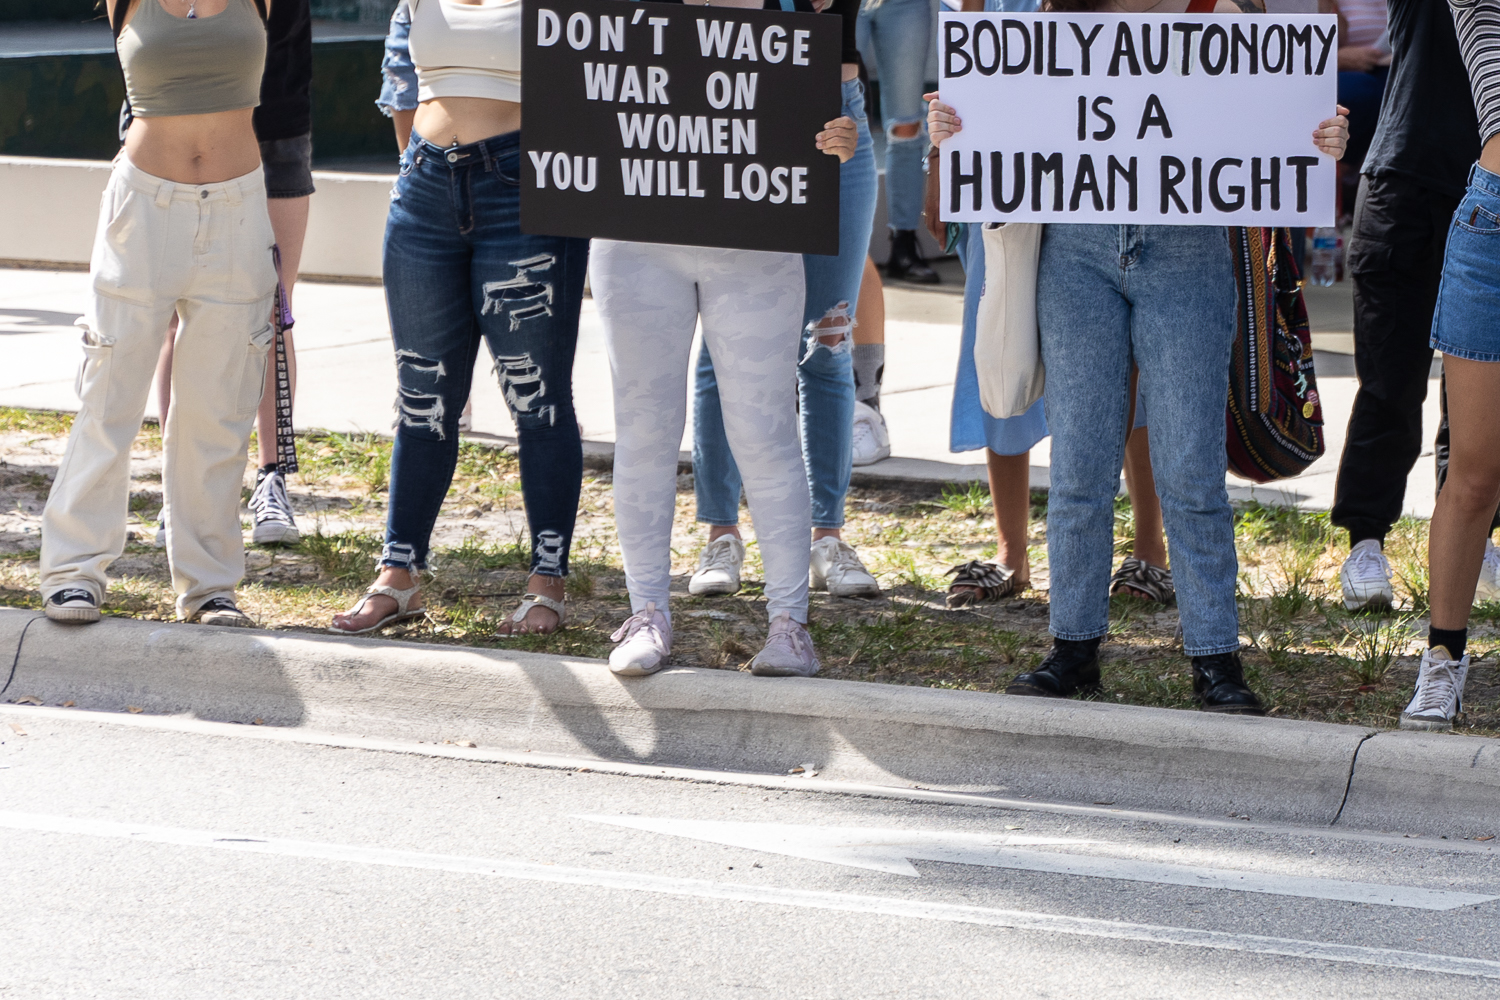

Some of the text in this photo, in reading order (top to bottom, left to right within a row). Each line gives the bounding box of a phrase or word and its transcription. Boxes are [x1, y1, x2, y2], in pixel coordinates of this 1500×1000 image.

[536, 8, 811, 66] DON'T WAGE
[943, 19, 1337, 78] BODILY AUTONOMY
[583, 61, 758, 110] WAR ON
[617, 112, 757, 155] WOMEN
[1077, 93, 1173, 142] IS A
[527, 150, 808, 205] YOU WILL LOSE
[949, 150, 1320, 214] HUMAN RIGHT
